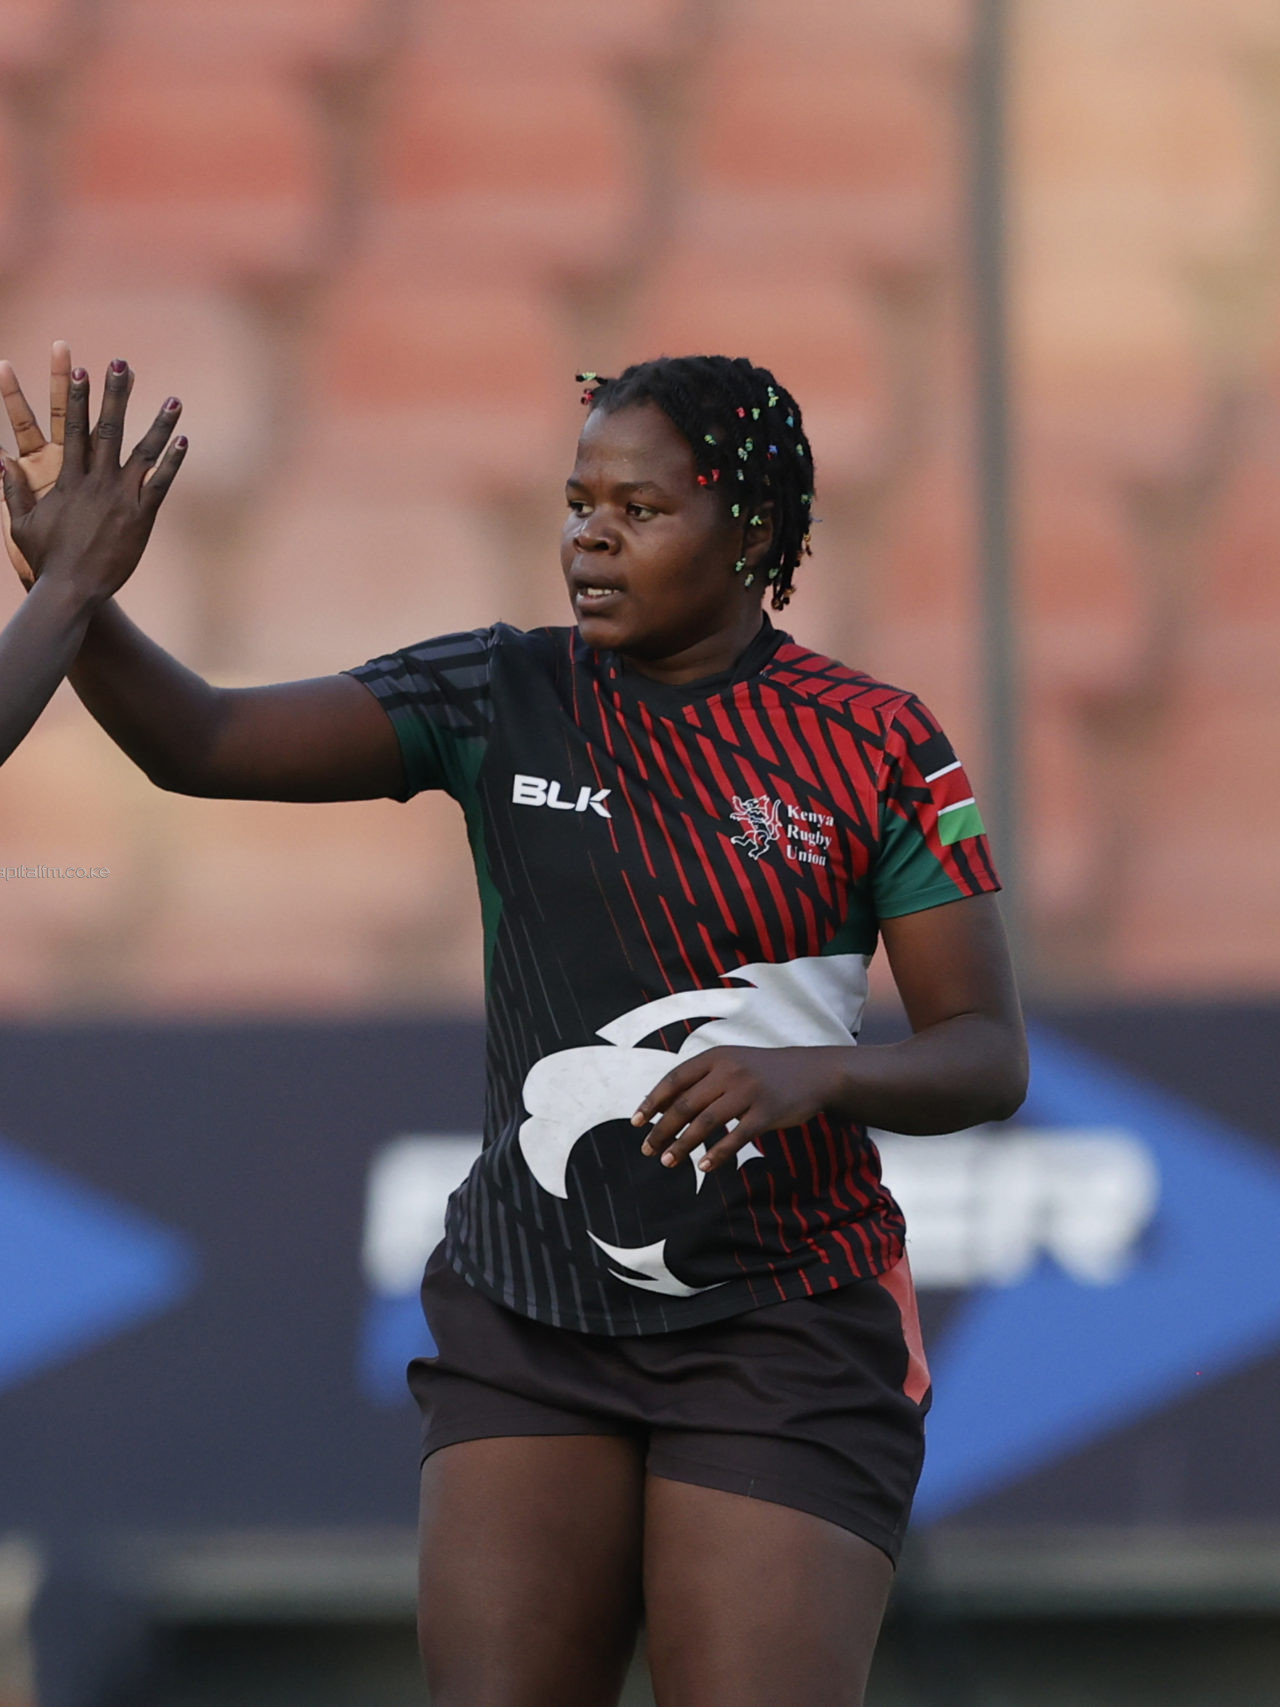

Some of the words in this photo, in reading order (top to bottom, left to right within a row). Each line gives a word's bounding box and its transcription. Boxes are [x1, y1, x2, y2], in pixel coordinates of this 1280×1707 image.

[512, 774, 612, 818] BLK
[787, 804, 834, 827] Kenya
[787, 824, 832, 849] Rugby
[786, 844, 826, 866] Union
